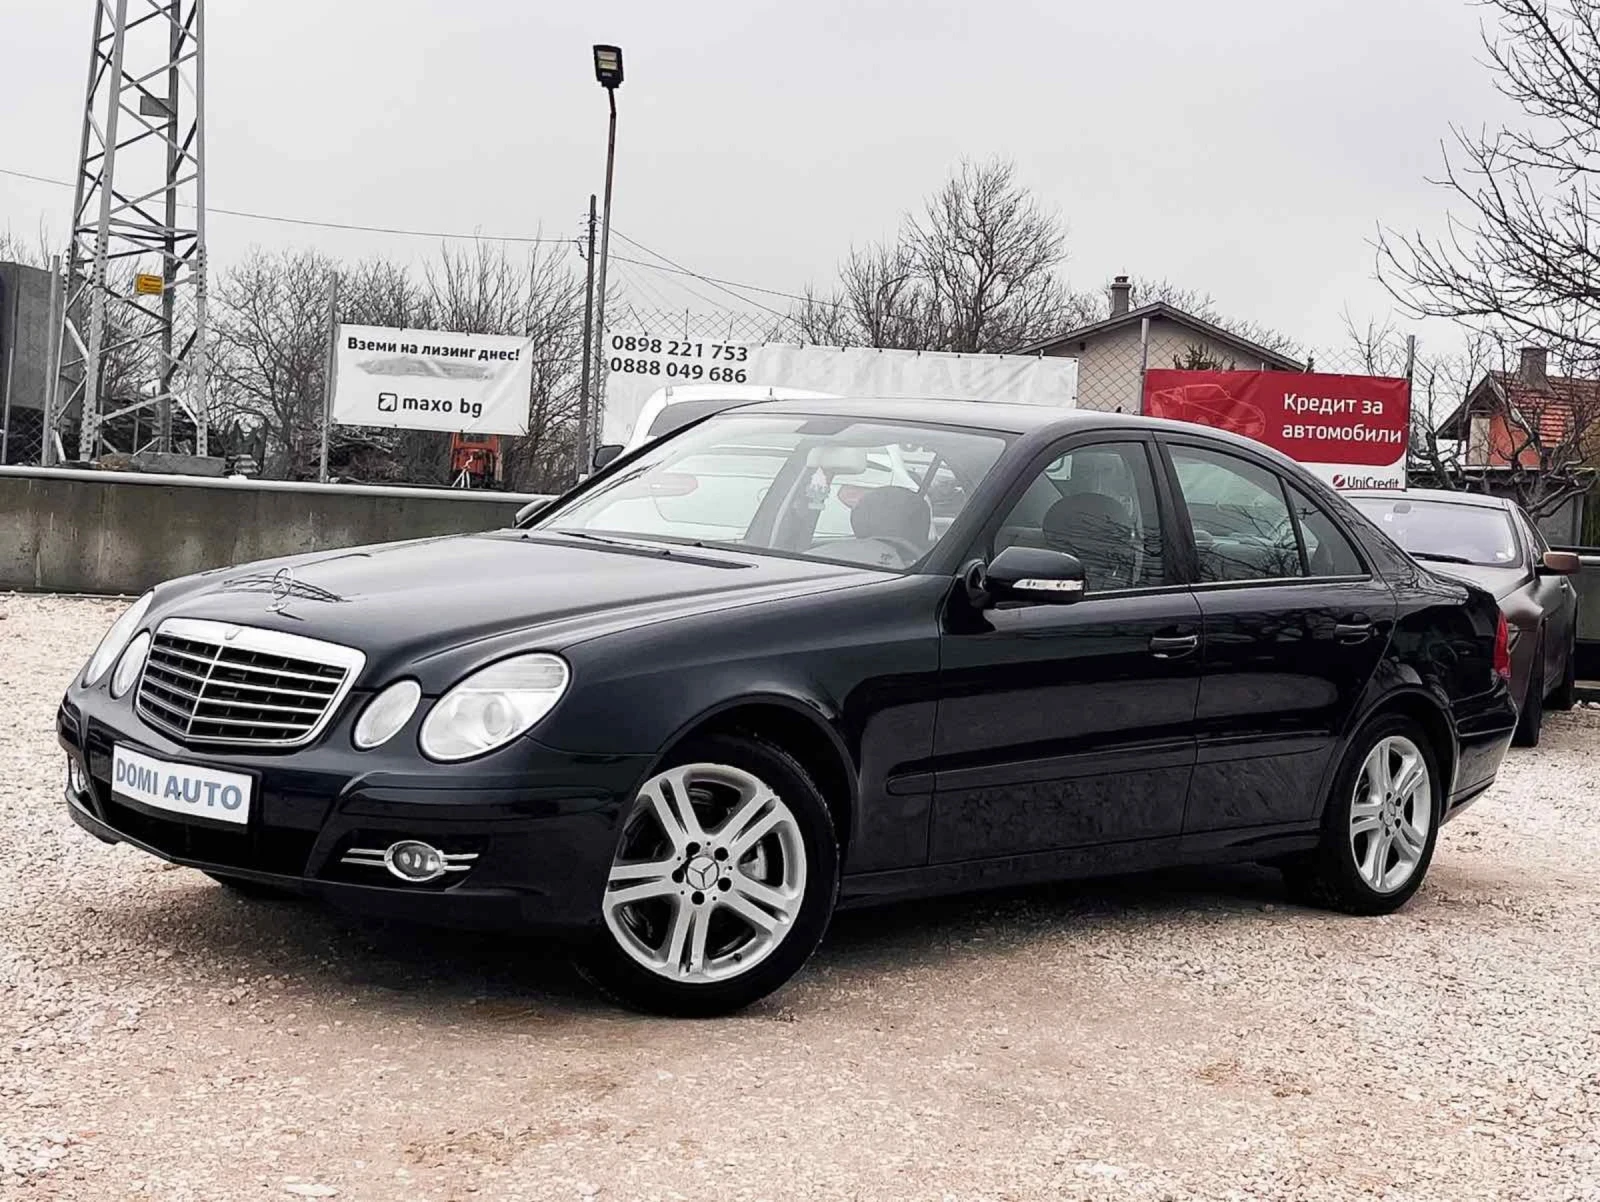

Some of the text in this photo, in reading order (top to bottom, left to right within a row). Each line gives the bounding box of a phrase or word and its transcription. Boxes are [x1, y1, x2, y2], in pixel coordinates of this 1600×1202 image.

[347, 336, 520, 361] Вземи на лизинг днес!
[611, 335, 748, 361] 0898 221 753
[610, 357, 747, 384] 0888 049 686
[402, 397, 483, 418] maxo bg
[1283, 393, 1383, 415] Кредит за
[1282, 424, 1402, 443] автомобили
[1347, 475, 1399, 489] UniCredit
[116, 758, 243, 811] DOMI AUTO
